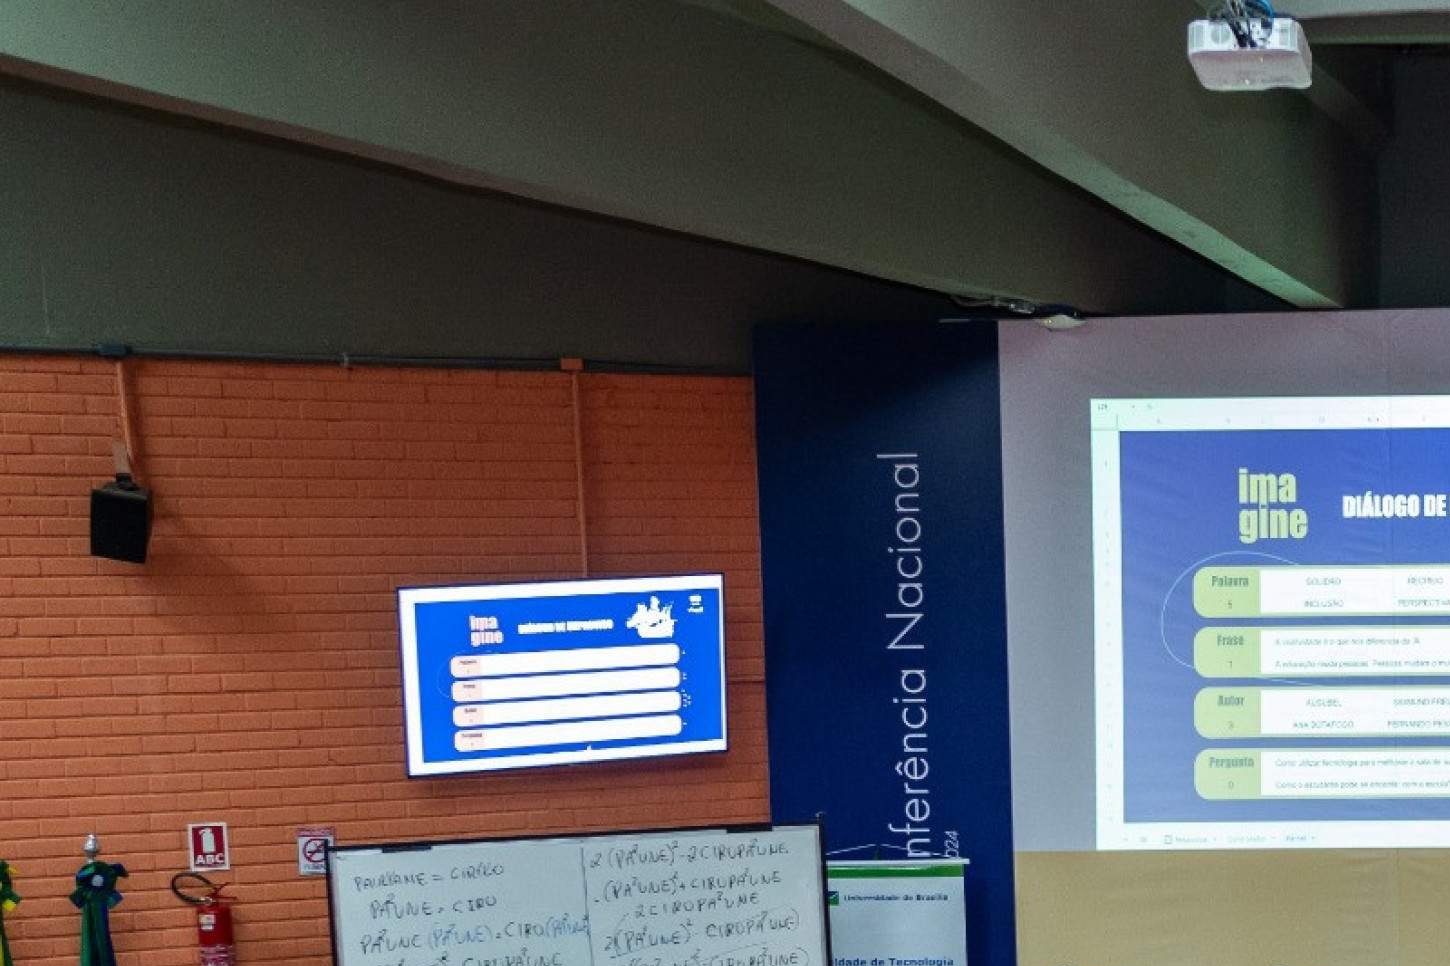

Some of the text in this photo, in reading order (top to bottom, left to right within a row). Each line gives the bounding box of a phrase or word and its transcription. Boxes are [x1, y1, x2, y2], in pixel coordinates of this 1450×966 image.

[1239, 468, 1297, 503] ima
[1342, 490, 1421, 519] DIÁLOGO
[1423, 494, 1447, 518] DE
[1239, 503, 1309, 544] gine
[1211, 575, 1250, 588] Palavra
[1216, 634, 1245, 647] Frase
[876, 453, 932, 858] nferência Nacional
[1217, 695, 1245, 707] Autor
[1208, 756, 1255, 769] Pergunta
[944, 830, 960, 858] 024
[195, 853, 225, 866] ABC
[843, 893, 900, 902] Universidade
[903, 893, 914, 902] de
[453, 896, 497, 914] CIRO
[870, 957, 885, 966] de
